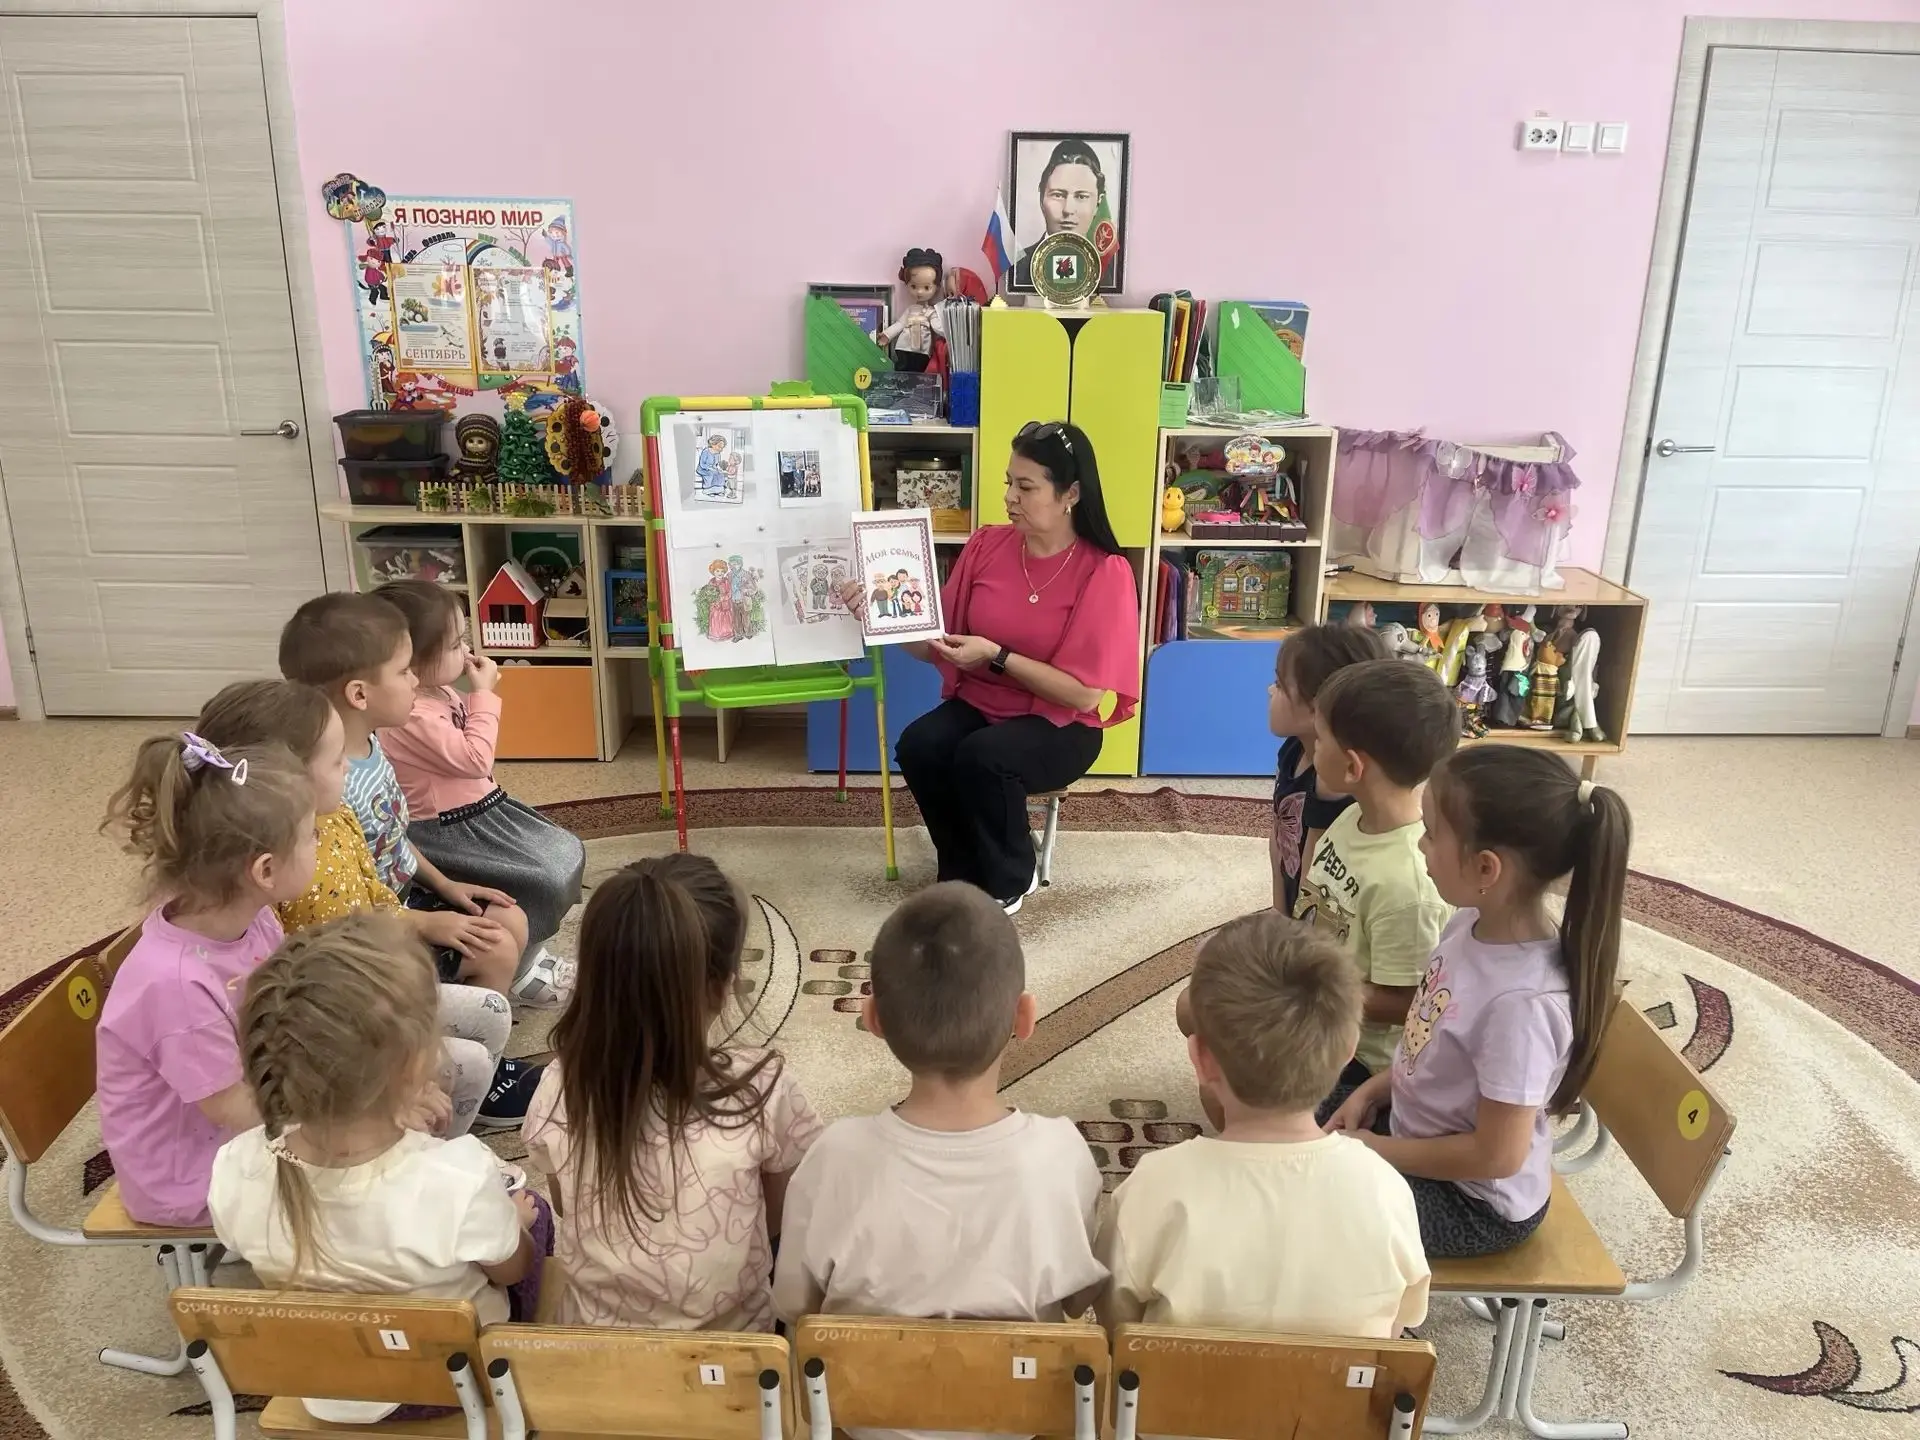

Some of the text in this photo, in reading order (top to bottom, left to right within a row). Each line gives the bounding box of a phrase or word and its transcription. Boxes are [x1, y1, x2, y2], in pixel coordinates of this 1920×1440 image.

[394, 208, 543, 226] Я ПОЗНАЮ МИР
[405, 348, 466, 360] СЕНТЯБРЬ
[858, 374, 868, 383] 17
[865, 549, 887, 566] Моя
[889, 547, 921, 561] семья
[76, 988, 92, 1008] 12
[1687, 1108, 1699, 1125] 4
[387, 1333, 398, 1346] 1
[709, 1368, 718, 1382] 1
[1019, 1362, 1027, 1375] 1
[1356, 1370, 1365, 1385] 1
